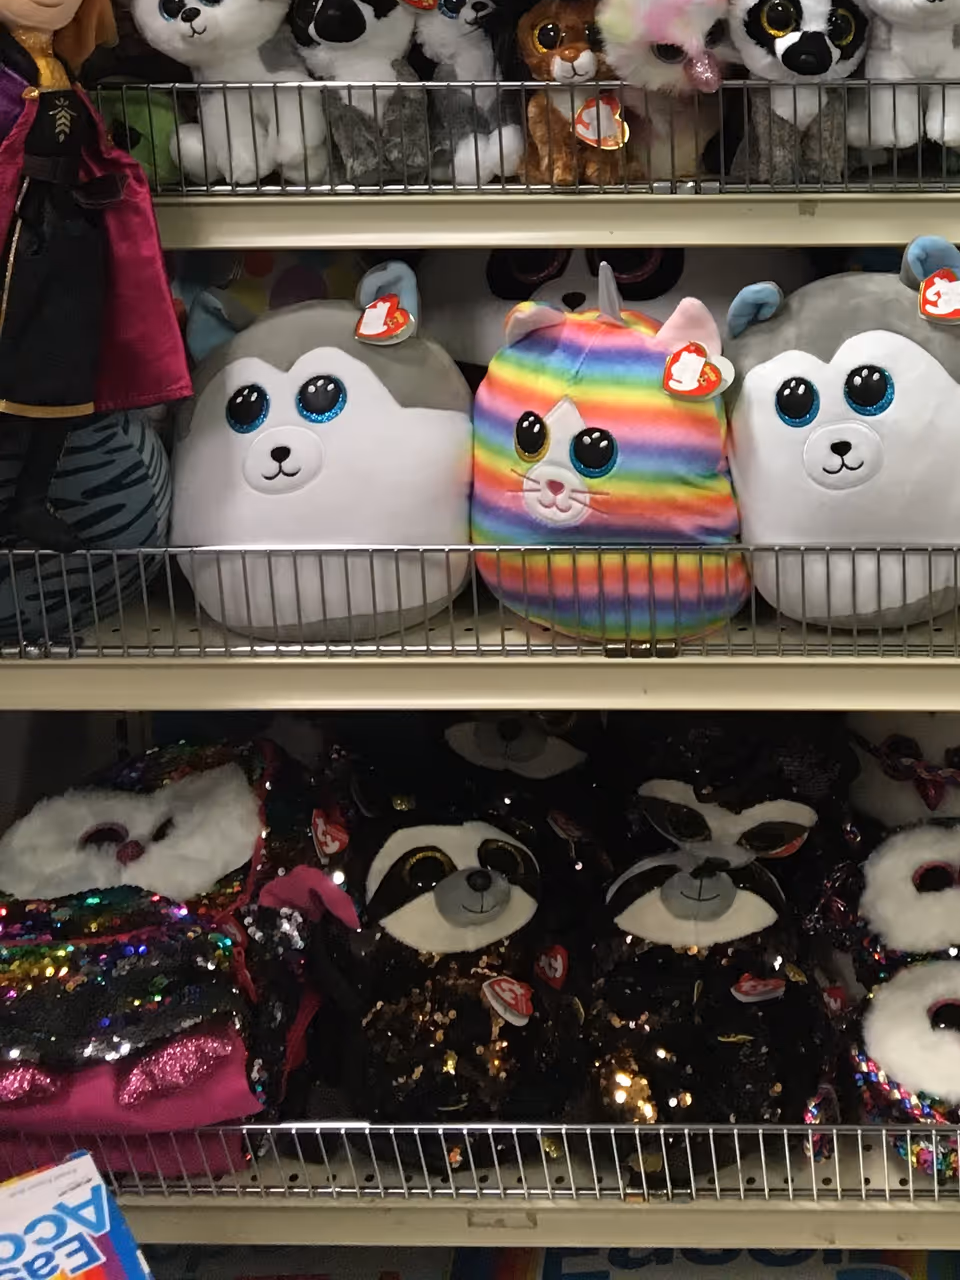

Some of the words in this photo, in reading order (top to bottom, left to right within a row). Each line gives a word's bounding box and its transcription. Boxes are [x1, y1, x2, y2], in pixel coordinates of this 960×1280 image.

[315, 817, 340, 853] ty
[541, 954, 563, 978] ty
[495, 983, 525, 1005] ty
